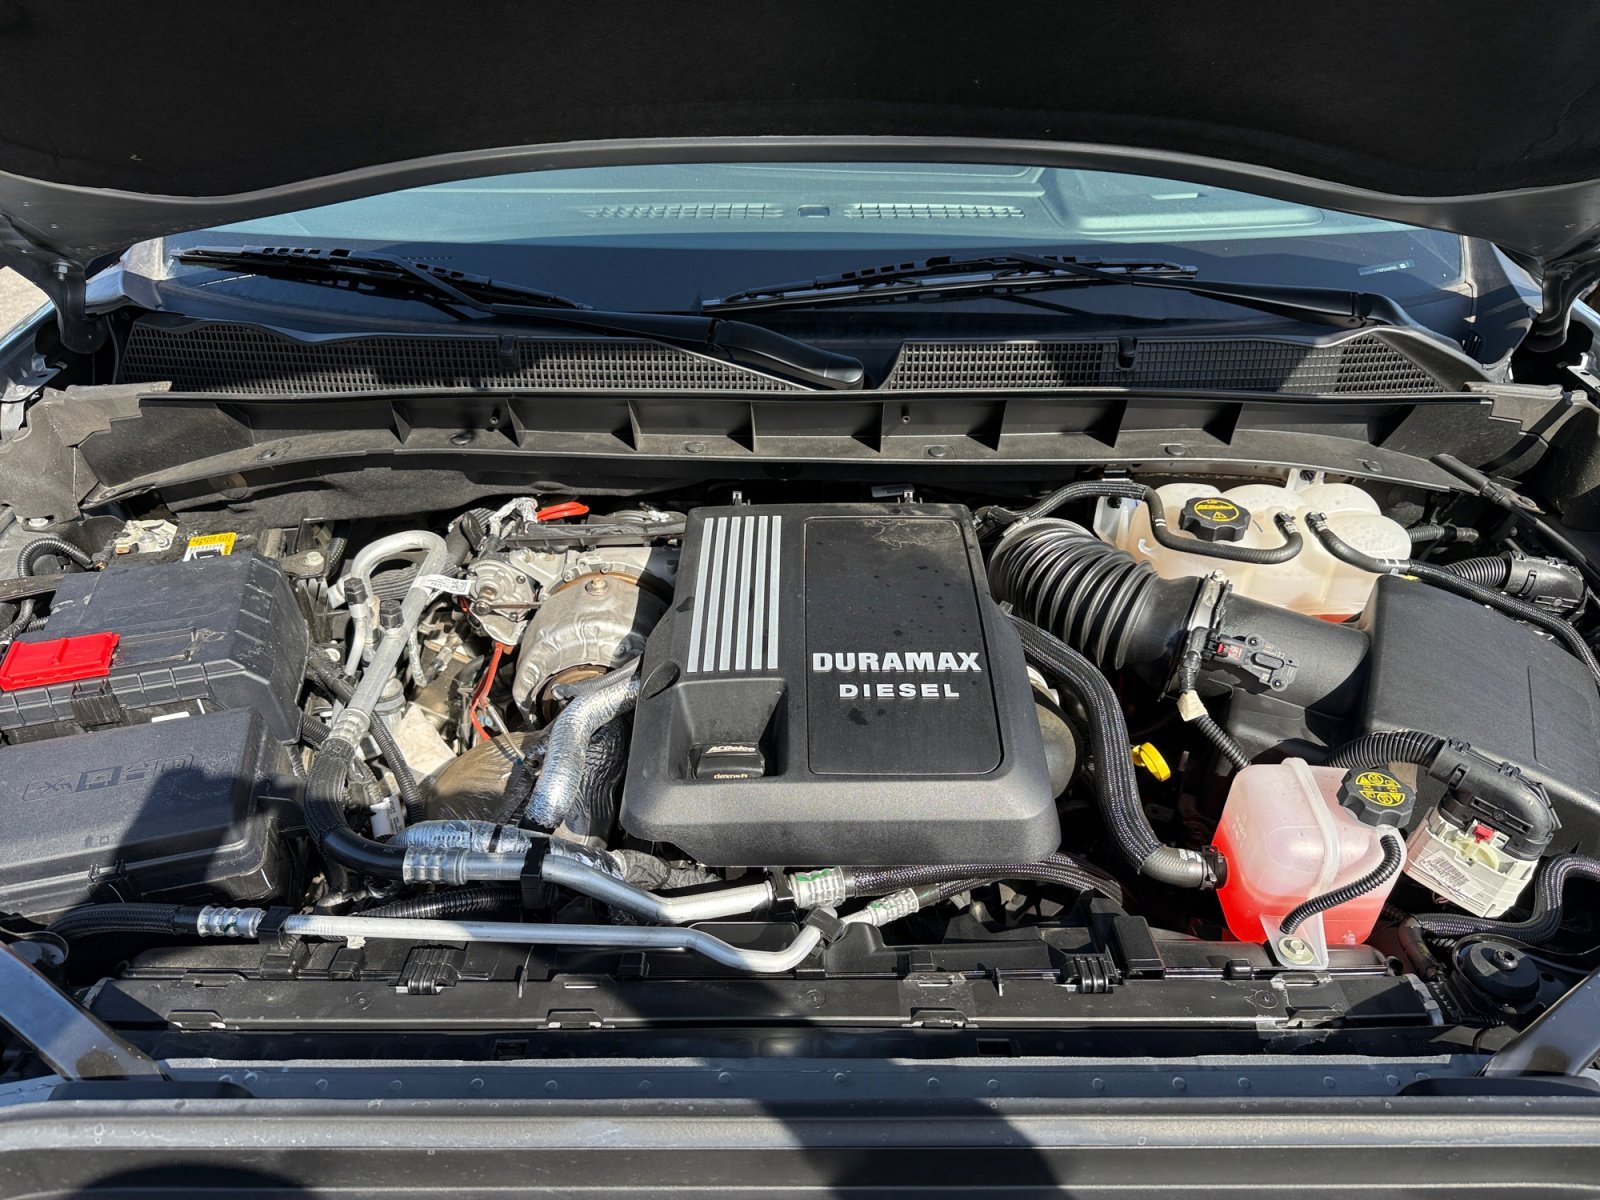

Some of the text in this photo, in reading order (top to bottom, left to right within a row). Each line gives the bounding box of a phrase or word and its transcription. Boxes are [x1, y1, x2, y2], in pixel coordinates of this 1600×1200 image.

[812, 652, 982, 672] DURAMAX
[839, 683, 960, 699] DIESEL
[705, 745, 756, 754] ACDelco
